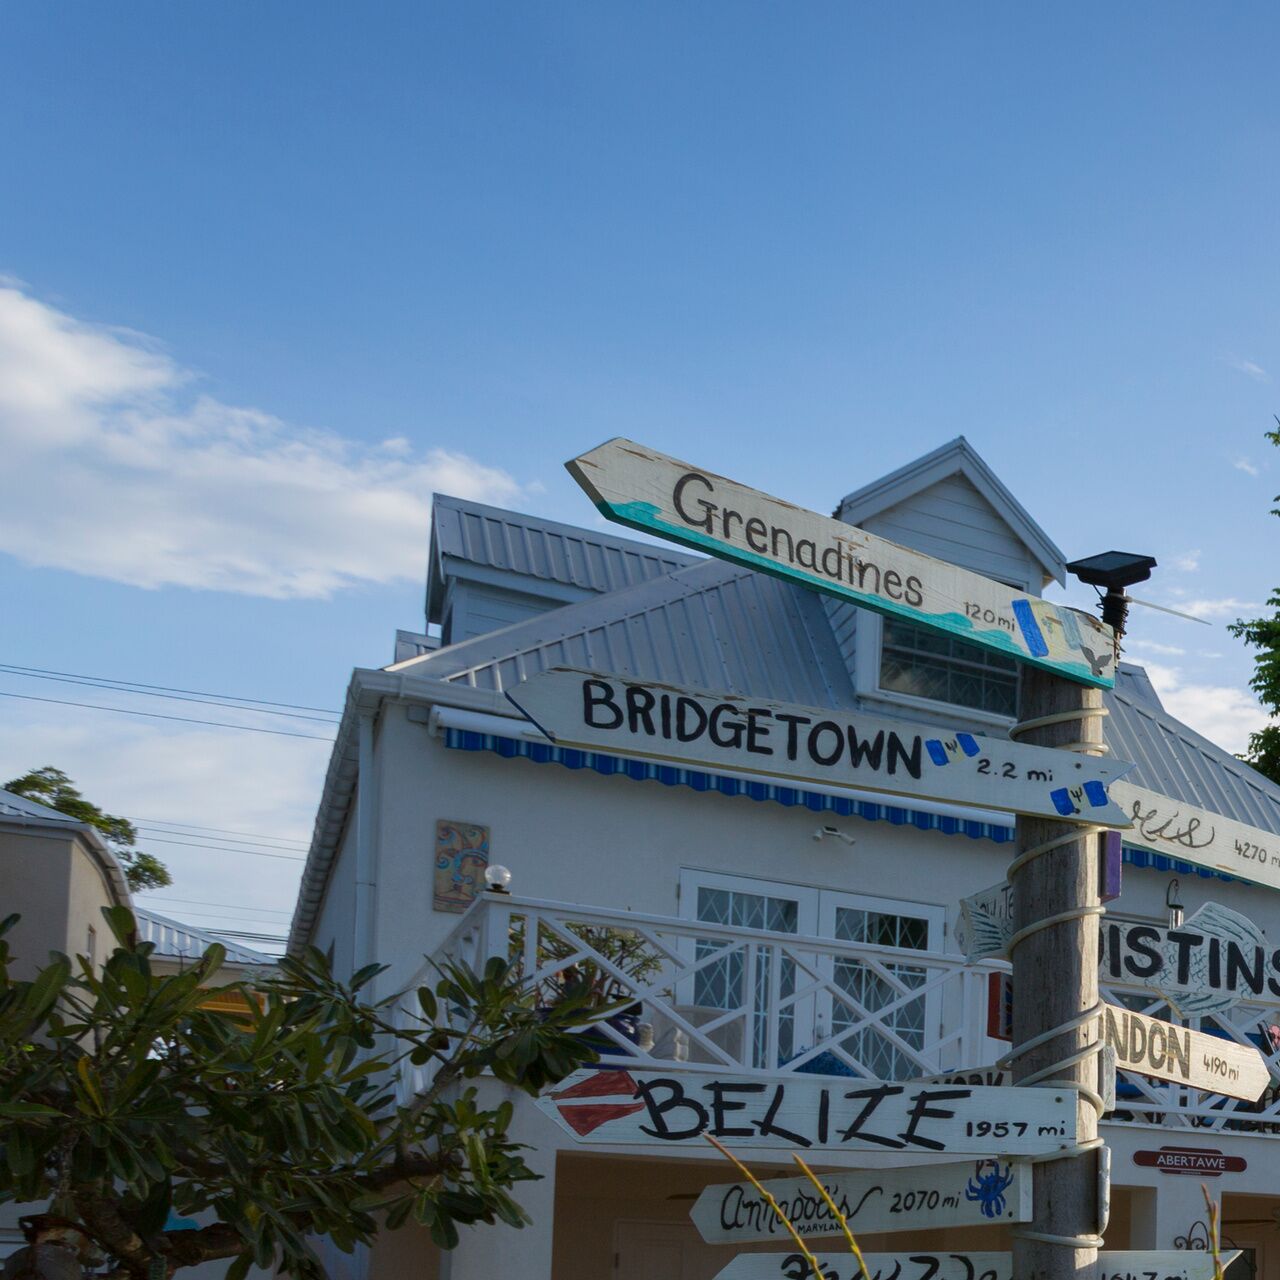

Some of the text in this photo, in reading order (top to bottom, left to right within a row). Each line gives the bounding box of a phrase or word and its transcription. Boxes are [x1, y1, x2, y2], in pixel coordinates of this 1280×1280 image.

[672, 472, 1015, 632] Grenadines 120 mi
[583, 679, 1054, 782] BRIDGETOWN 2.2 mi
[1131, 799, 1215, 848] ris
[1234, 839, 1268, 864] 4270
[1101, 1005, 1240, 1081] NDON 4190 mi
[633, 1079, 1066, 1151] BELIZE 1957 mi
[1157, 1155, 1226, 1169] ABERTAWE
[797, 1223, 842, 1235] MARYLAN
[889, 1191, 938, 1214] 2070
[941, 1192, 960, 1208] mi
